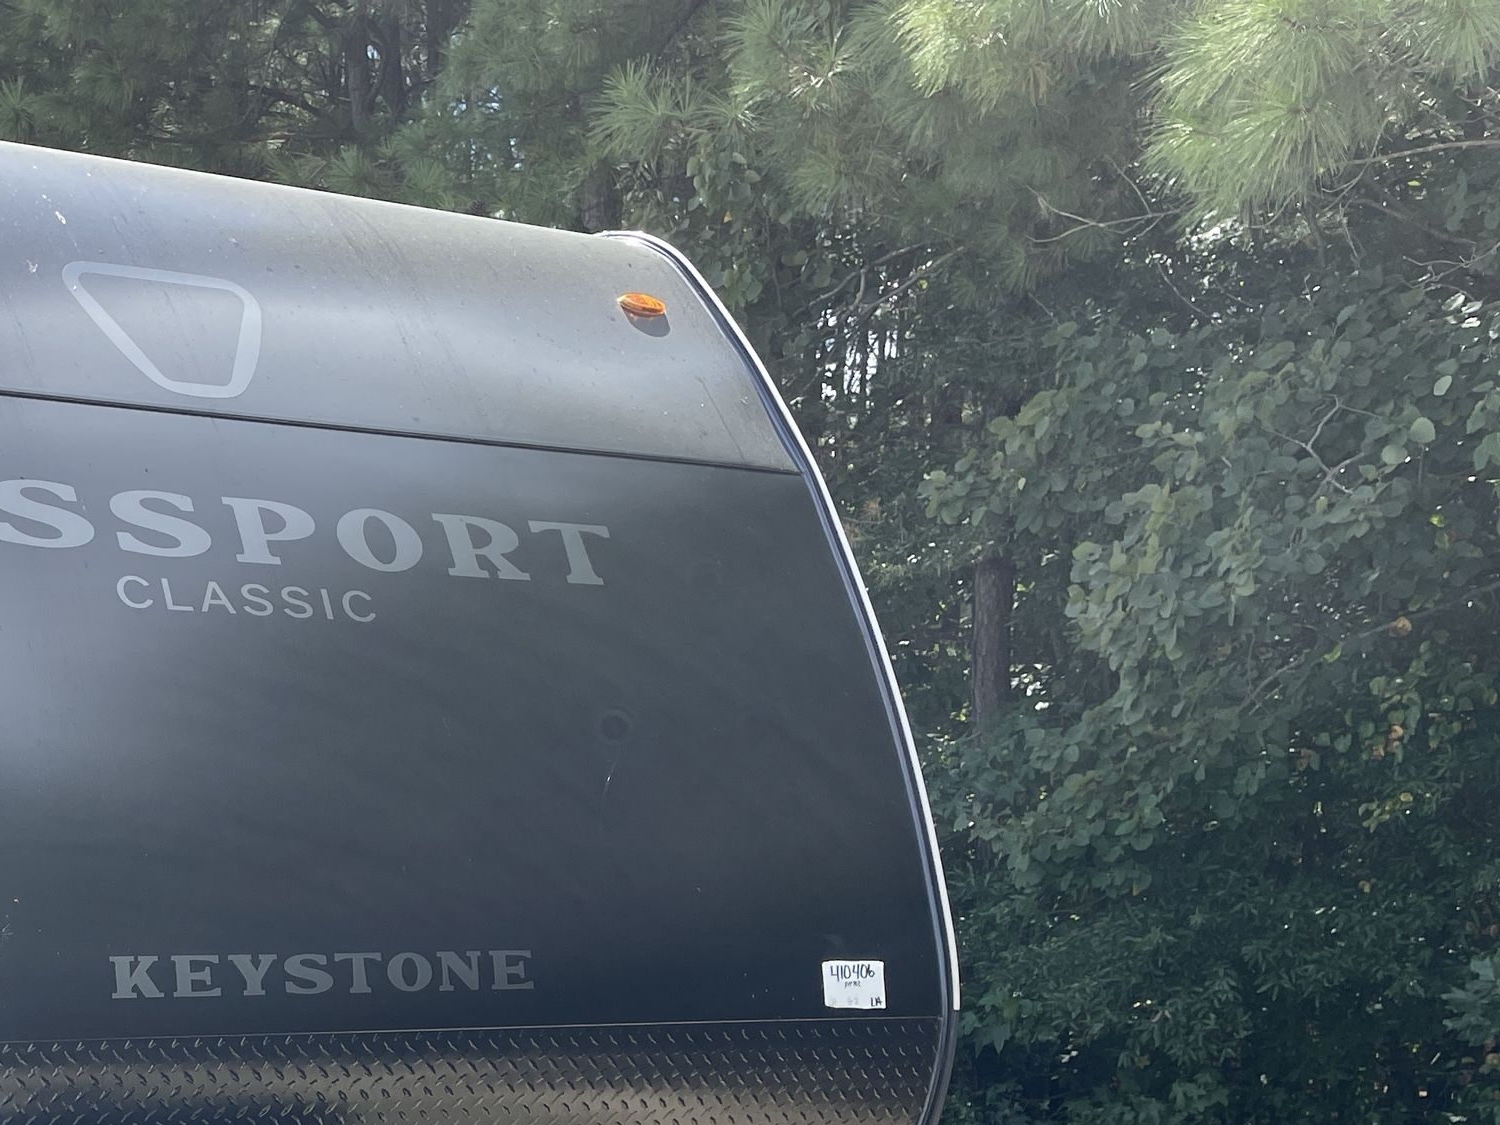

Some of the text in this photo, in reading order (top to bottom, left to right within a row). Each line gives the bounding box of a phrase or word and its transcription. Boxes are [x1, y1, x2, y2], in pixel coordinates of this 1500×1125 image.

[115, 574, 377, 623] CLASSIC
[109, 949, 535, 1000] KEYSTONE
[830, 963, 875, 982] 410406
